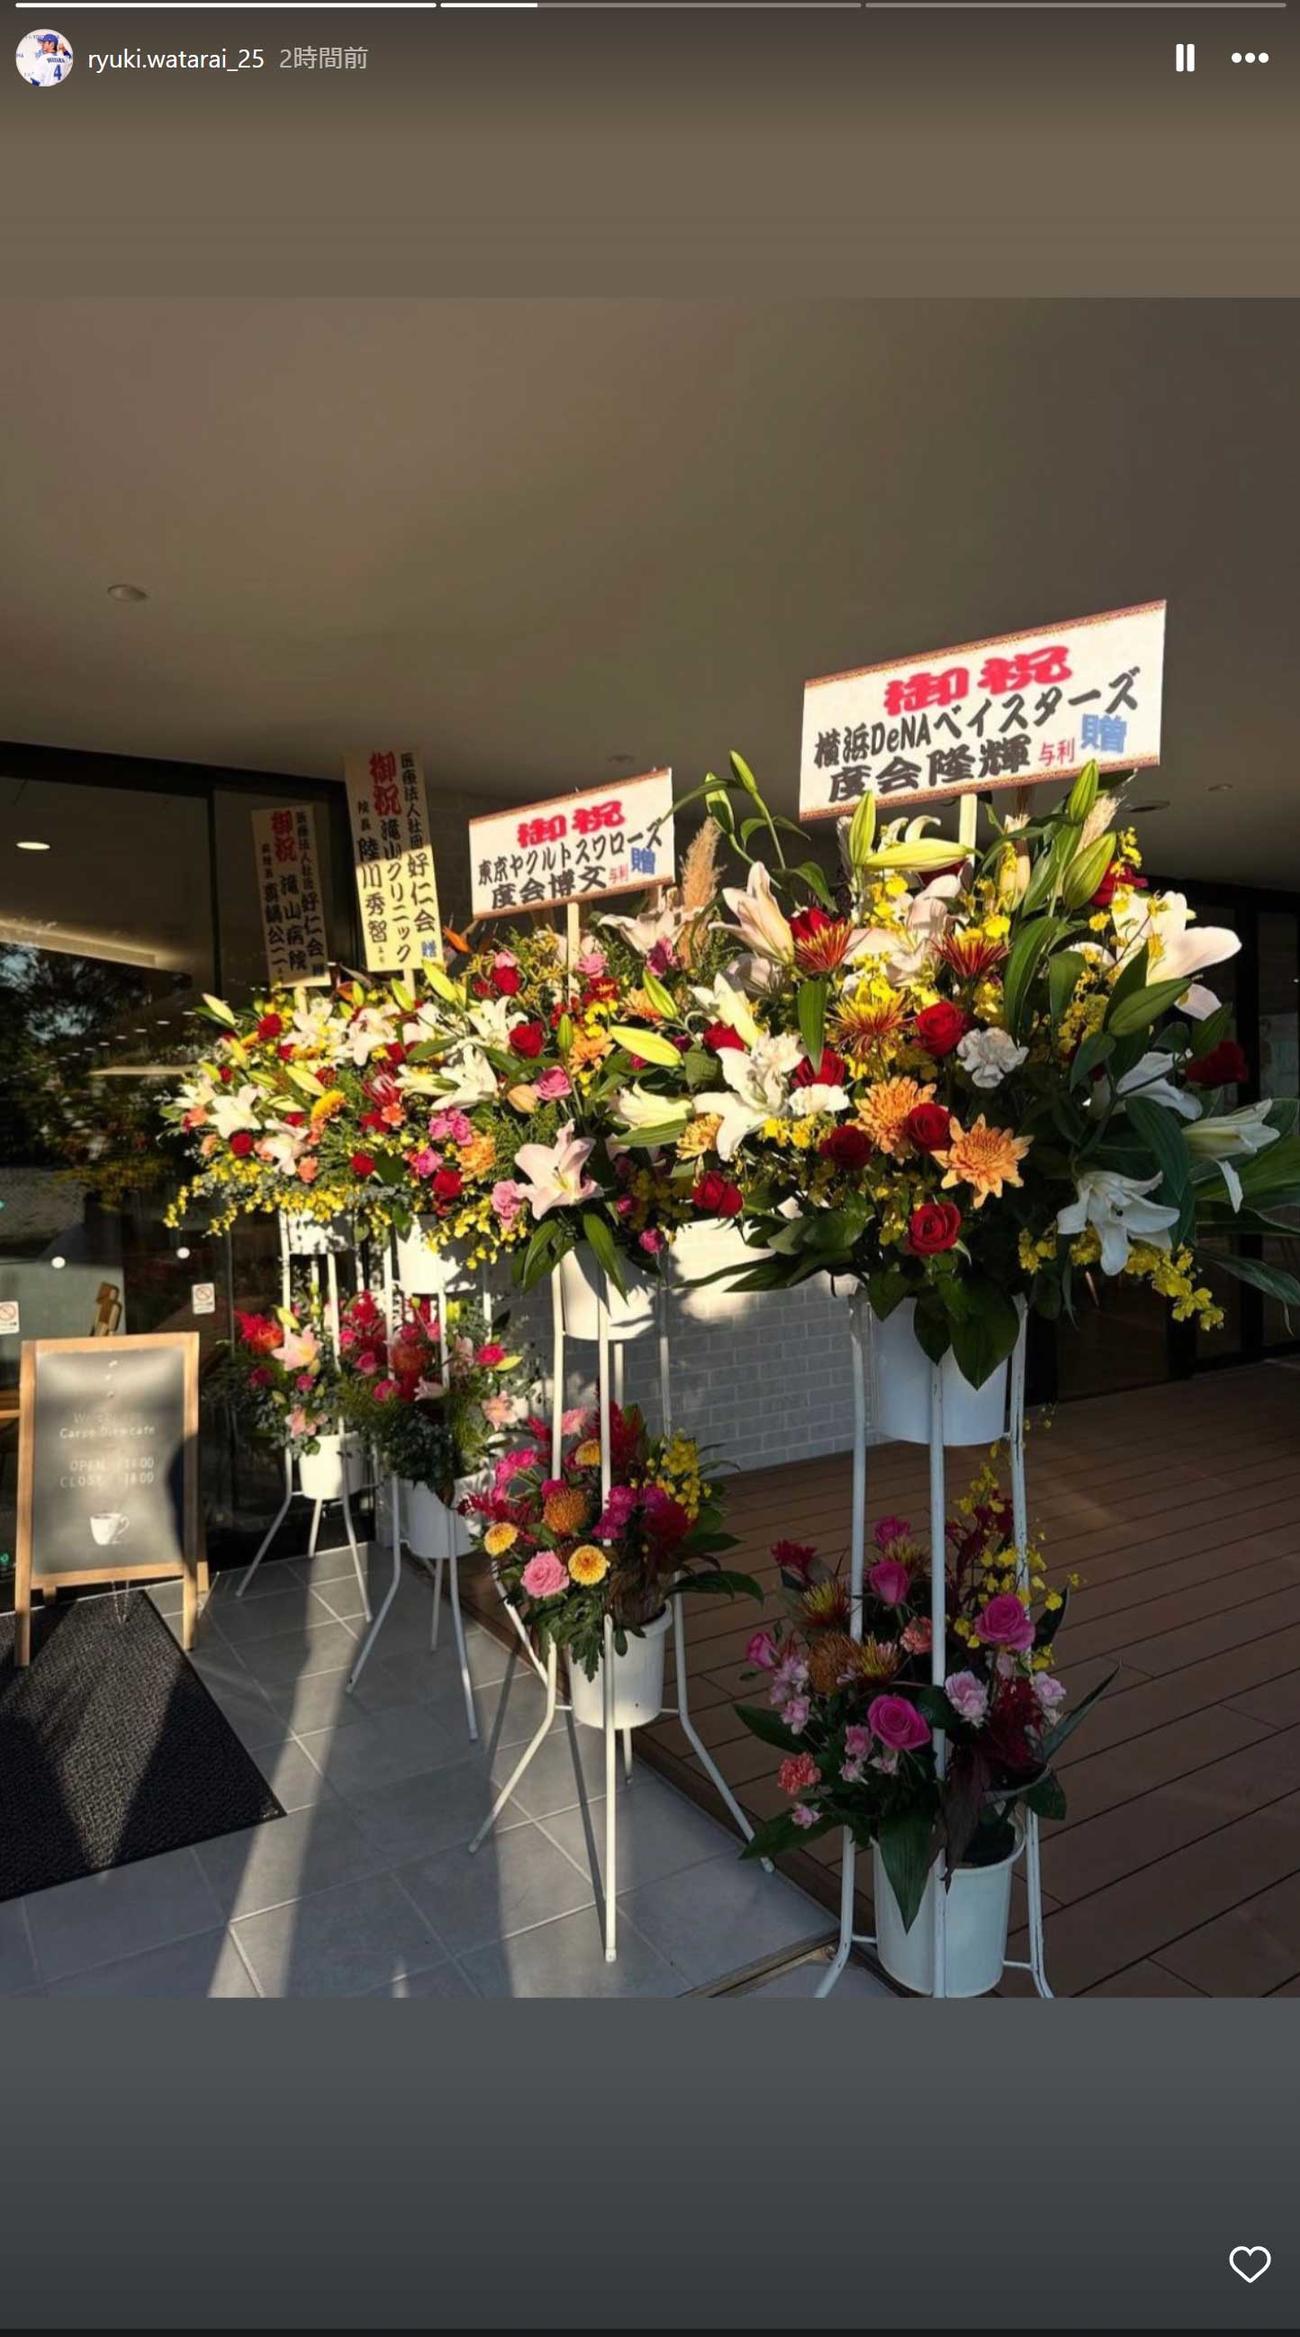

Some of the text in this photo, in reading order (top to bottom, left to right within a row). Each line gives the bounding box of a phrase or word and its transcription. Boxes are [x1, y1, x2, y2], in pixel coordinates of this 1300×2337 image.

[883, 645, 1073, 717] 御祝
[814, 666, 1141, 769] 横浜DeNAベイスターズ
[1080, 714, 1128, 754] 贈
[369, 751, 402, 816] 御祝
[828, 734, 1032, 802] 度会隆輝
[271, 810, 298, 863] 御祝
[478, 817, 663, 885] 東京ヤクルトスワローズ
[517, 801, 625, 848] 御祝
[358, 837, 388, 943] 陸川秀智
[407, 852, 436, 934] 好仁会
[492, 866, 607, 910] 度会博文
